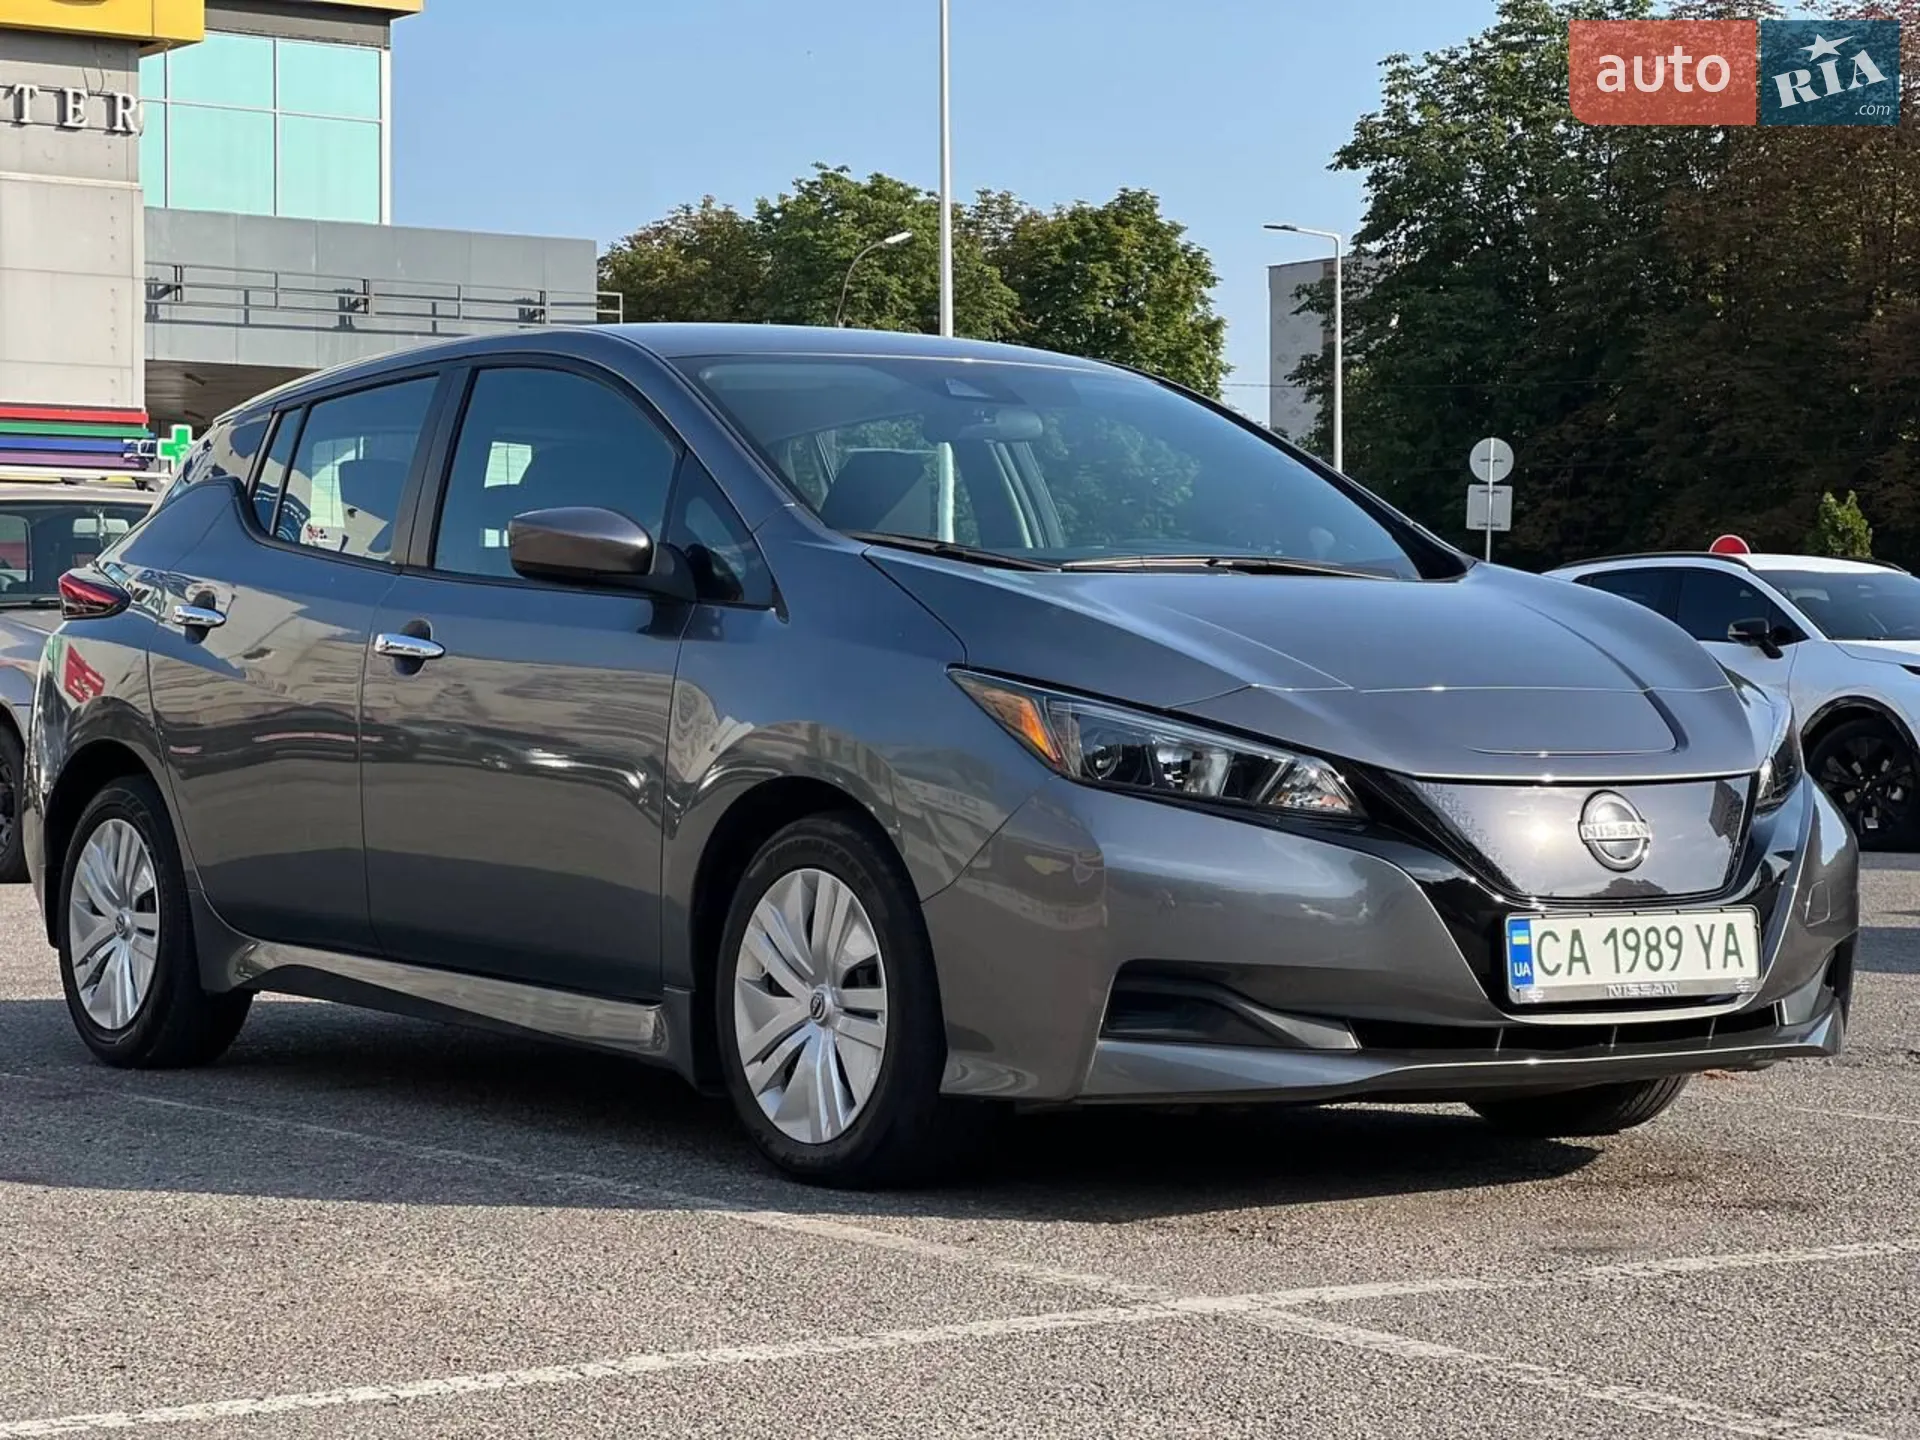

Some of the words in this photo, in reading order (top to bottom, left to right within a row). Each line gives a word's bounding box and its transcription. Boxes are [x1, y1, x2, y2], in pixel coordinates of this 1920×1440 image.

[1582, 823, 1649, 838] NISSAN
[1536, 929, 1591, 976] CA
[1603, 925, 1683, 974] 1989
[1695, 922, 1744, 970] YA
[1514, 962, 1531, 977] UA
[1606, 982, 1680, 998] NISSAN
